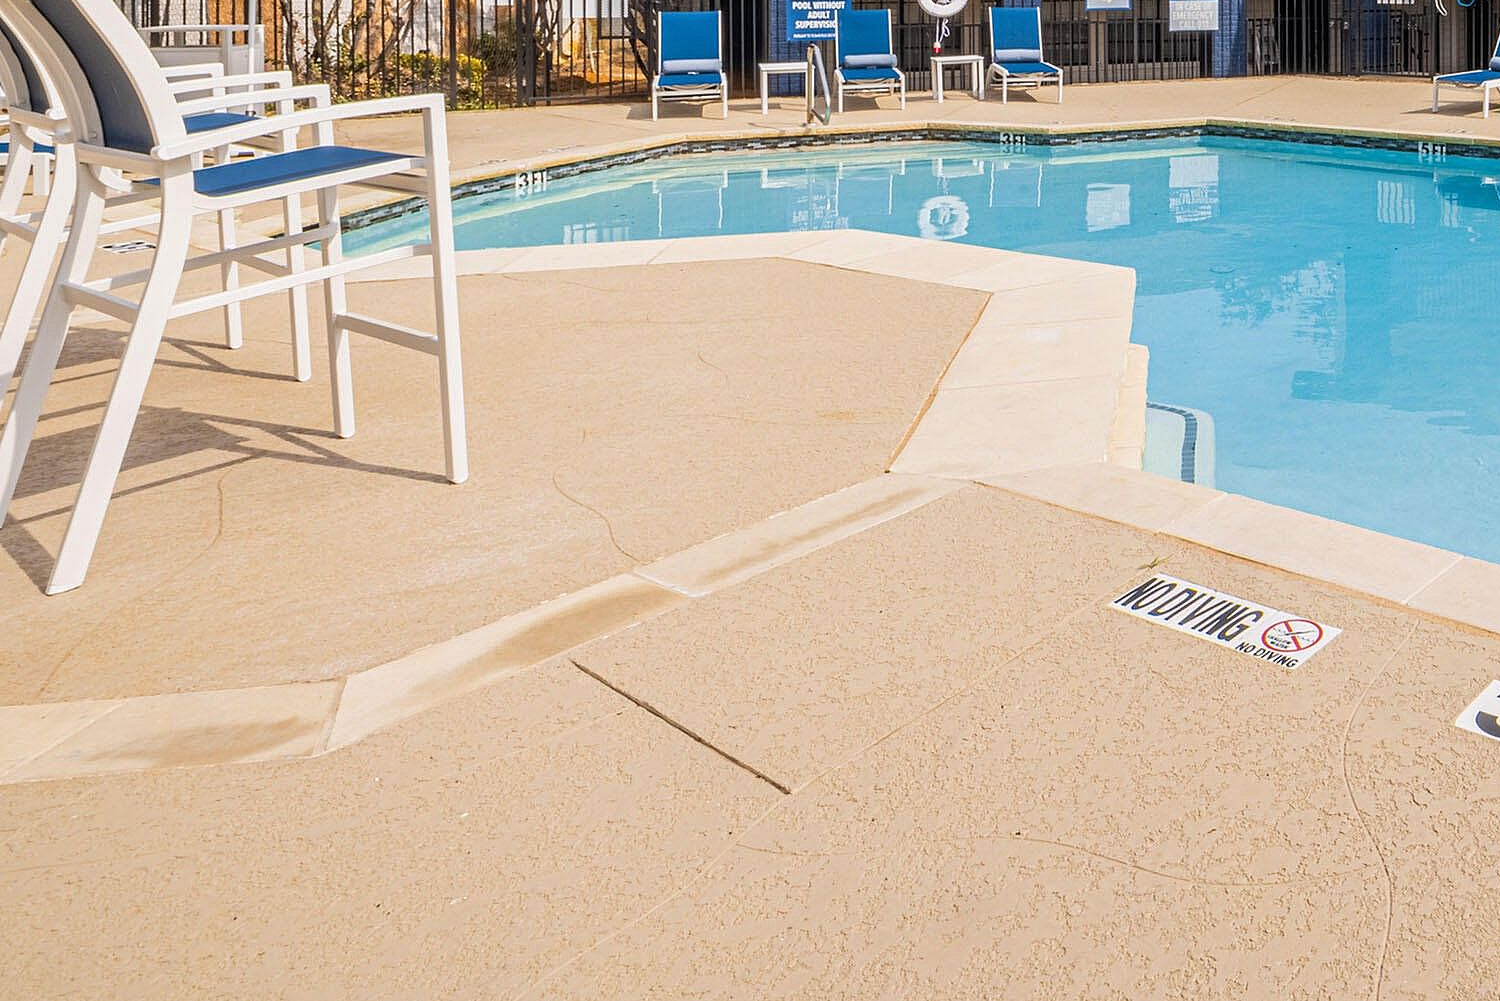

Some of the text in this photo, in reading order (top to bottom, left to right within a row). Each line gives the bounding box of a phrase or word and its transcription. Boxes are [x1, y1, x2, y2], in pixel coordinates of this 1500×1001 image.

[792, 1, 846, 10] POOL WITHOUT
[807, 10, 830, 19] ADULT
[795, 20, 837, 29] SUPERVISIO
[1000, 132, 1012, 145] 3
[1421, 142, 1446, 156] 5 FT
[518, 168, 546, 188] 3 FT
[1113, 577, 1265, 642] NO DIVING
[1235, 641, 1299, 668] NO DIVING
